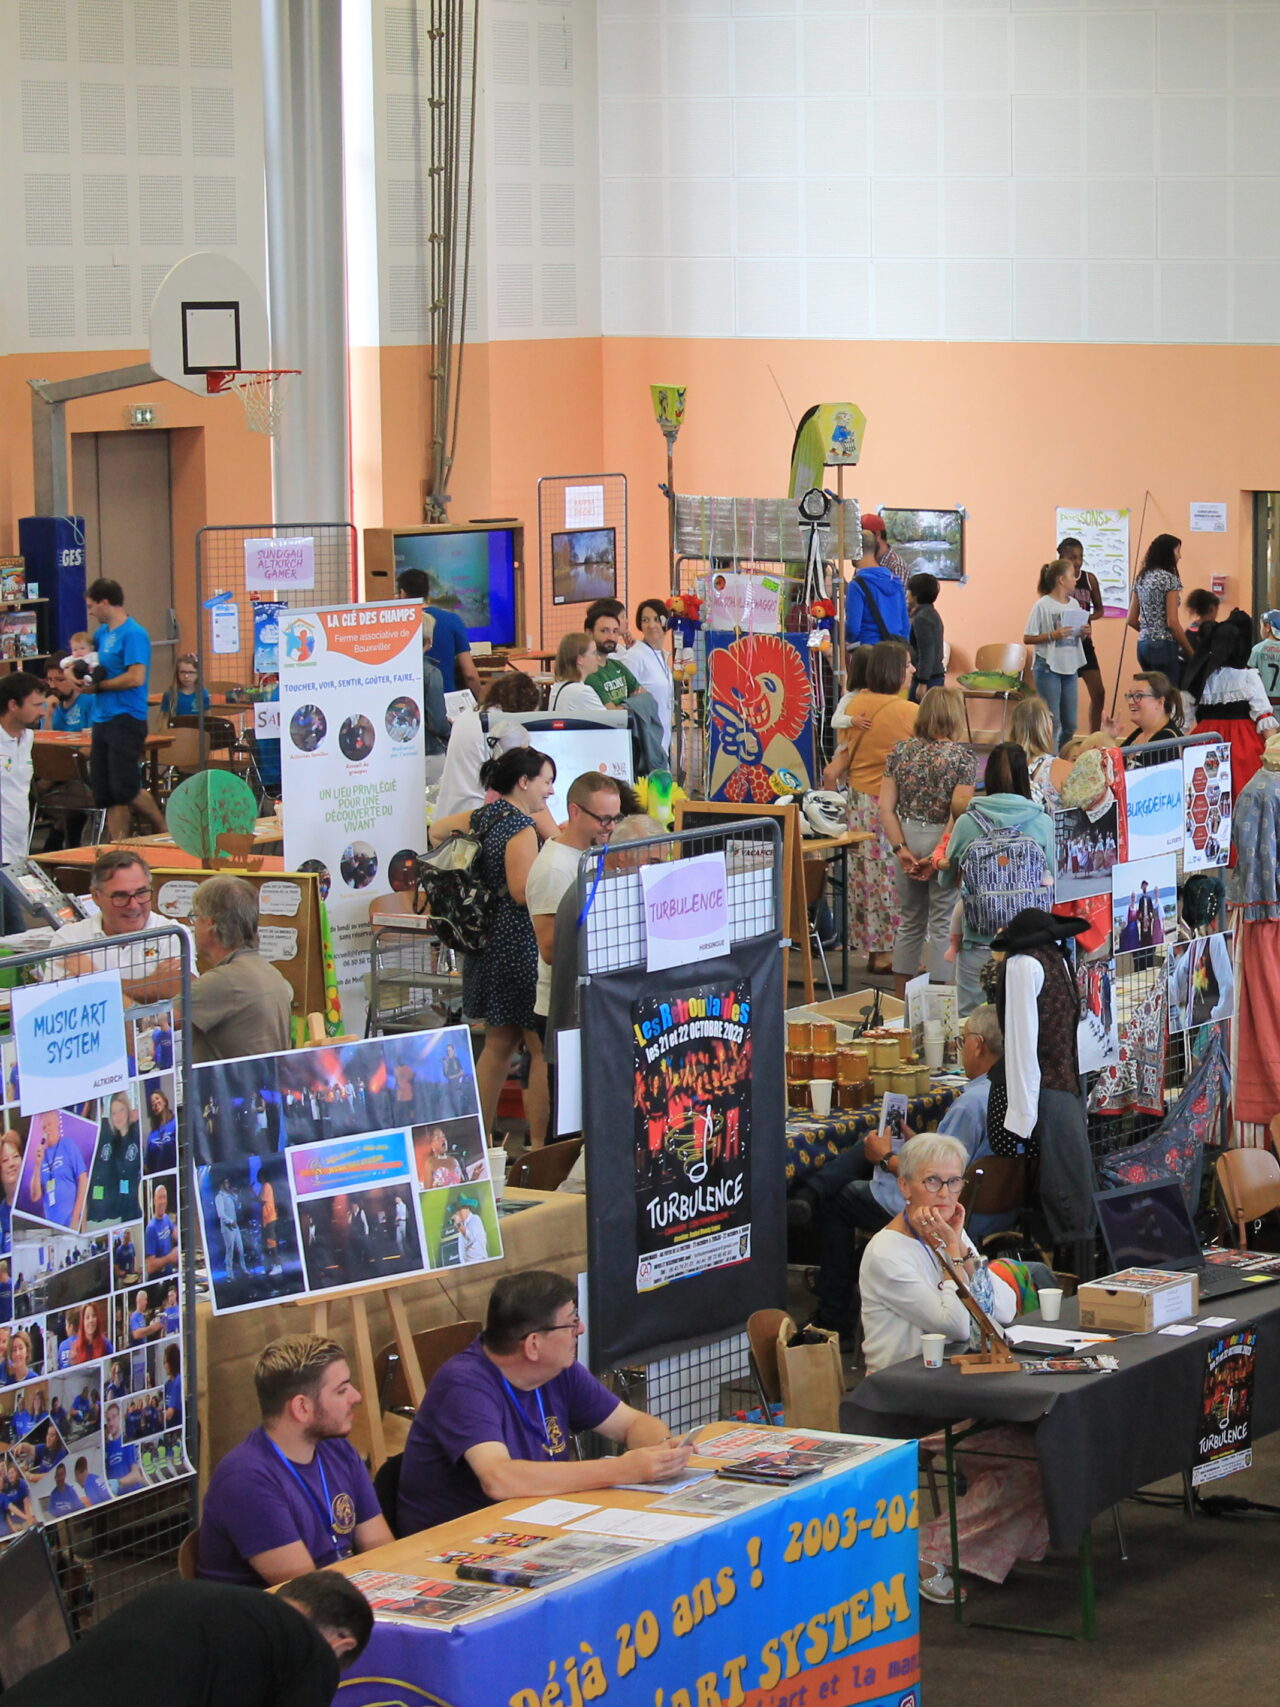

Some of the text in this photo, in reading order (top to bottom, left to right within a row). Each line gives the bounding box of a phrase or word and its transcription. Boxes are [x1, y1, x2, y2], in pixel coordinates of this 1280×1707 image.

[61, 549, 82, 567] GES
[257, 550, 303, 560] SUNDGAU
[257, 559, 303, 570] ALTKIRCH
[264, 569, 297, 580] GAMER
[327, 608, 416, 627] LA CLÉ DES CHAMPS
[334, 629, 410, 642] Ferme associative de
[284, 683, 318, 693] TOUCHER,
[318, 681, 337, 690] VOIR,
[338, 678, 364, 688] SENTIR,
[365, 675, 392, 686] GOÛTER,
[393, 673, 415, 683] FAIRE,
[1267, 663, 1280, 692] 7
[319, 779, 398, 800] UN LIEU PRIVILÉGIÉ
[338, 795, 381, 809] POUR UNE
[325, 805, 393, 823] DÉCOUVERTE DU
[344, 818, 376, 832] VIVANT
[649, 888, 723, 923] TURBULENCE
[33, 999, 108, 1038] MUSIC ART
[633, 1017, 661, 1048] Les
[645, 1019, 744, 1064] les 21 et 22 OCTOBRE 2023
[47, 1030, 101, 1064] SYSTEM
[93, 1074, 124, 1088] ALTKIRCH
[646, 1172, 744, 1229] TURBULENCE
[1199, 1422, 1249, 1455] TURBULENCE
[505, 1641, 608, 1707] Déjà
[616, 1610, 660, 1677] 20
[672, 1566, 736, 1637] ans
[758, 1574, 911, 1691] SYSTEM
[818, 1673, 840, 1700] et
[852, 1664, 876, 1689] la
